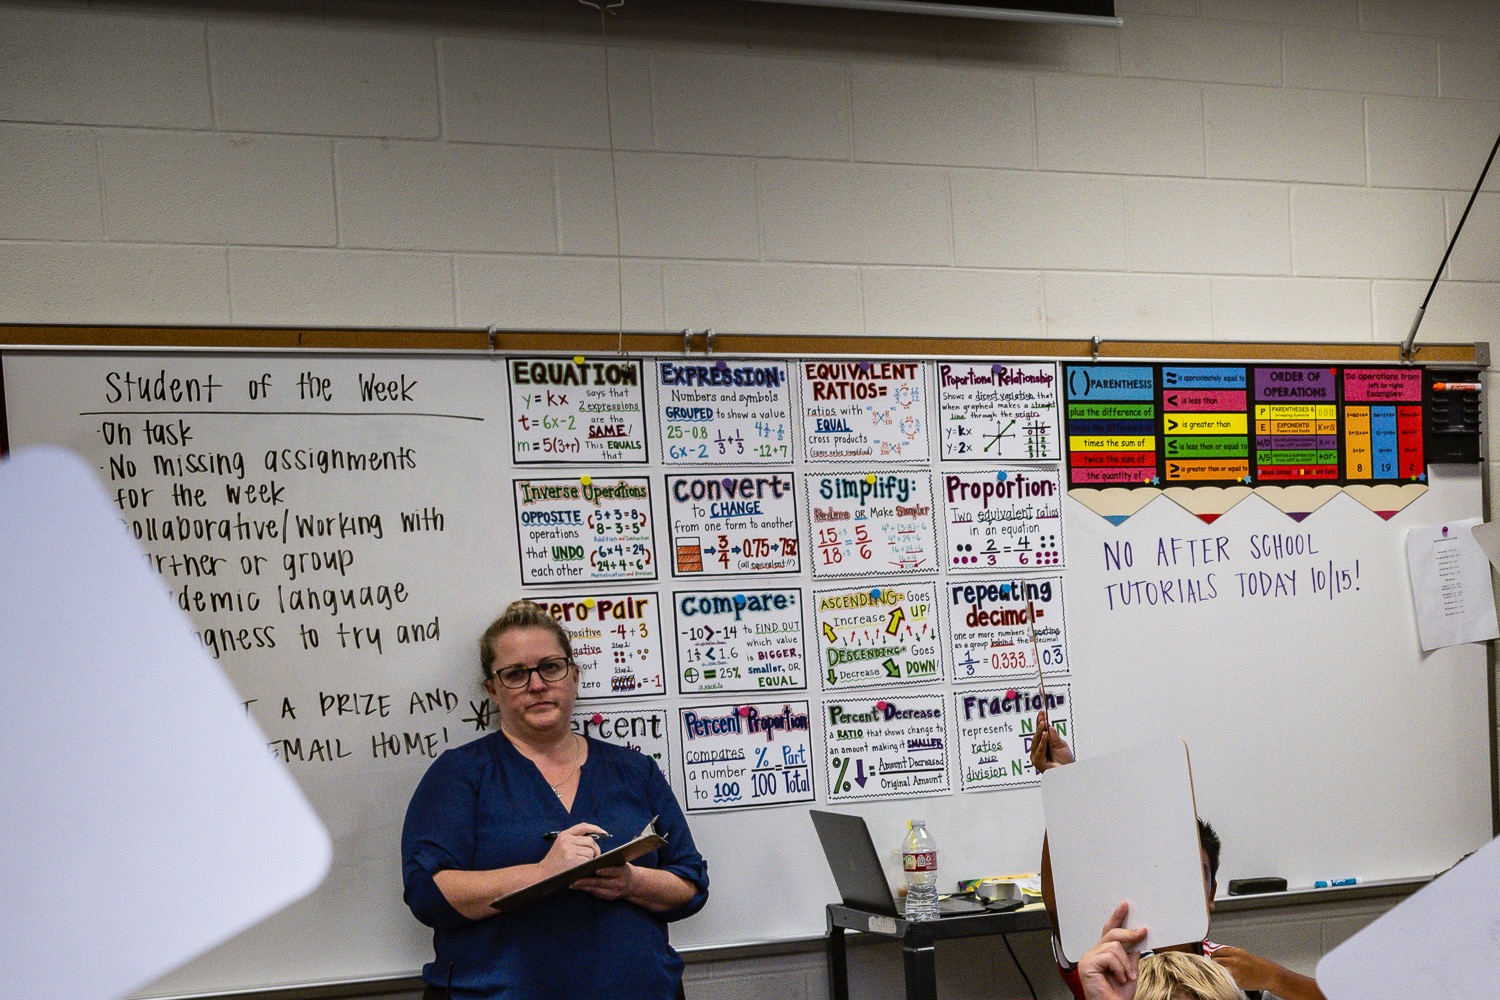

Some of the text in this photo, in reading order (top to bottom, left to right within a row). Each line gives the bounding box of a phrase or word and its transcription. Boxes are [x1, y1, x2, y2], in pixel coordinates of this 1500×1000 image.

[514, 362, 637, 385] EQUATION
[805, 364, 918, 380] EQUIVALENT
[940, 365, 1053, 387] Proportional Relationship
[1270, 372, 1320, 381] ORDER OF
[106, 370, 223, 403] Student
[249, 372, 271, 399] of
[297, 371, 332, 402] the
[1091, 379, 1152, 389] PARENTHESIS
[1264, 387, 1326, 397] OPERATIONS
[672, 389, 778, 405] Numbers and symbols
[666, 407, 713, 419] GROUPED
[716, 410, 725, 419] to
[727, 410, 748, 420] show
[761, 409, 785, 419] value
[1070, 408, 1151, 417] plus the difference of
[144, 419, 193, 445] task
[1190, 421, 1216, 431] greater
[110, 446, 417, 480] No missing assignments
[114, 487, 154, 509] for
[172, 484, 207, 507] the
[522, 482, 647, 507] Inverse Operations
[400, 507, 445, 533] with
[522, 510, 582, 523] OPPOSITE
[952, 504, 1059, 522] Two equivalent ratios
[552, 546, 584, 559] UNDO
[1104, 534, 1319, 570] NO AFTER SCHOOL
[240, 550, 354, 580] or group
[952, 581, 1052, 610] repeating
[1104, 560, 1360, 610] TUTORIALS TODAY 10/15!
[278, 581, 409, 616] language
[907, 591, 930, 602] Goes
[834, 614, 886, 626] Increase
[299, 624, 319, 650] to
[336, 621, 382, 654] try
[397, 617, 441, 644] and
[282, 697, 296, 720] A
[319, 692, 391, 717] PRIZE
[410, 688, 459, 715] AND
[830, 703, 941, 725] Percent Decrease
[684, 706, 808, 741] Percent Proportion
[686, 748, 745, 763] compares
[689, 767, 747, 781] a number
[694, 783, 740, 799] to 100
